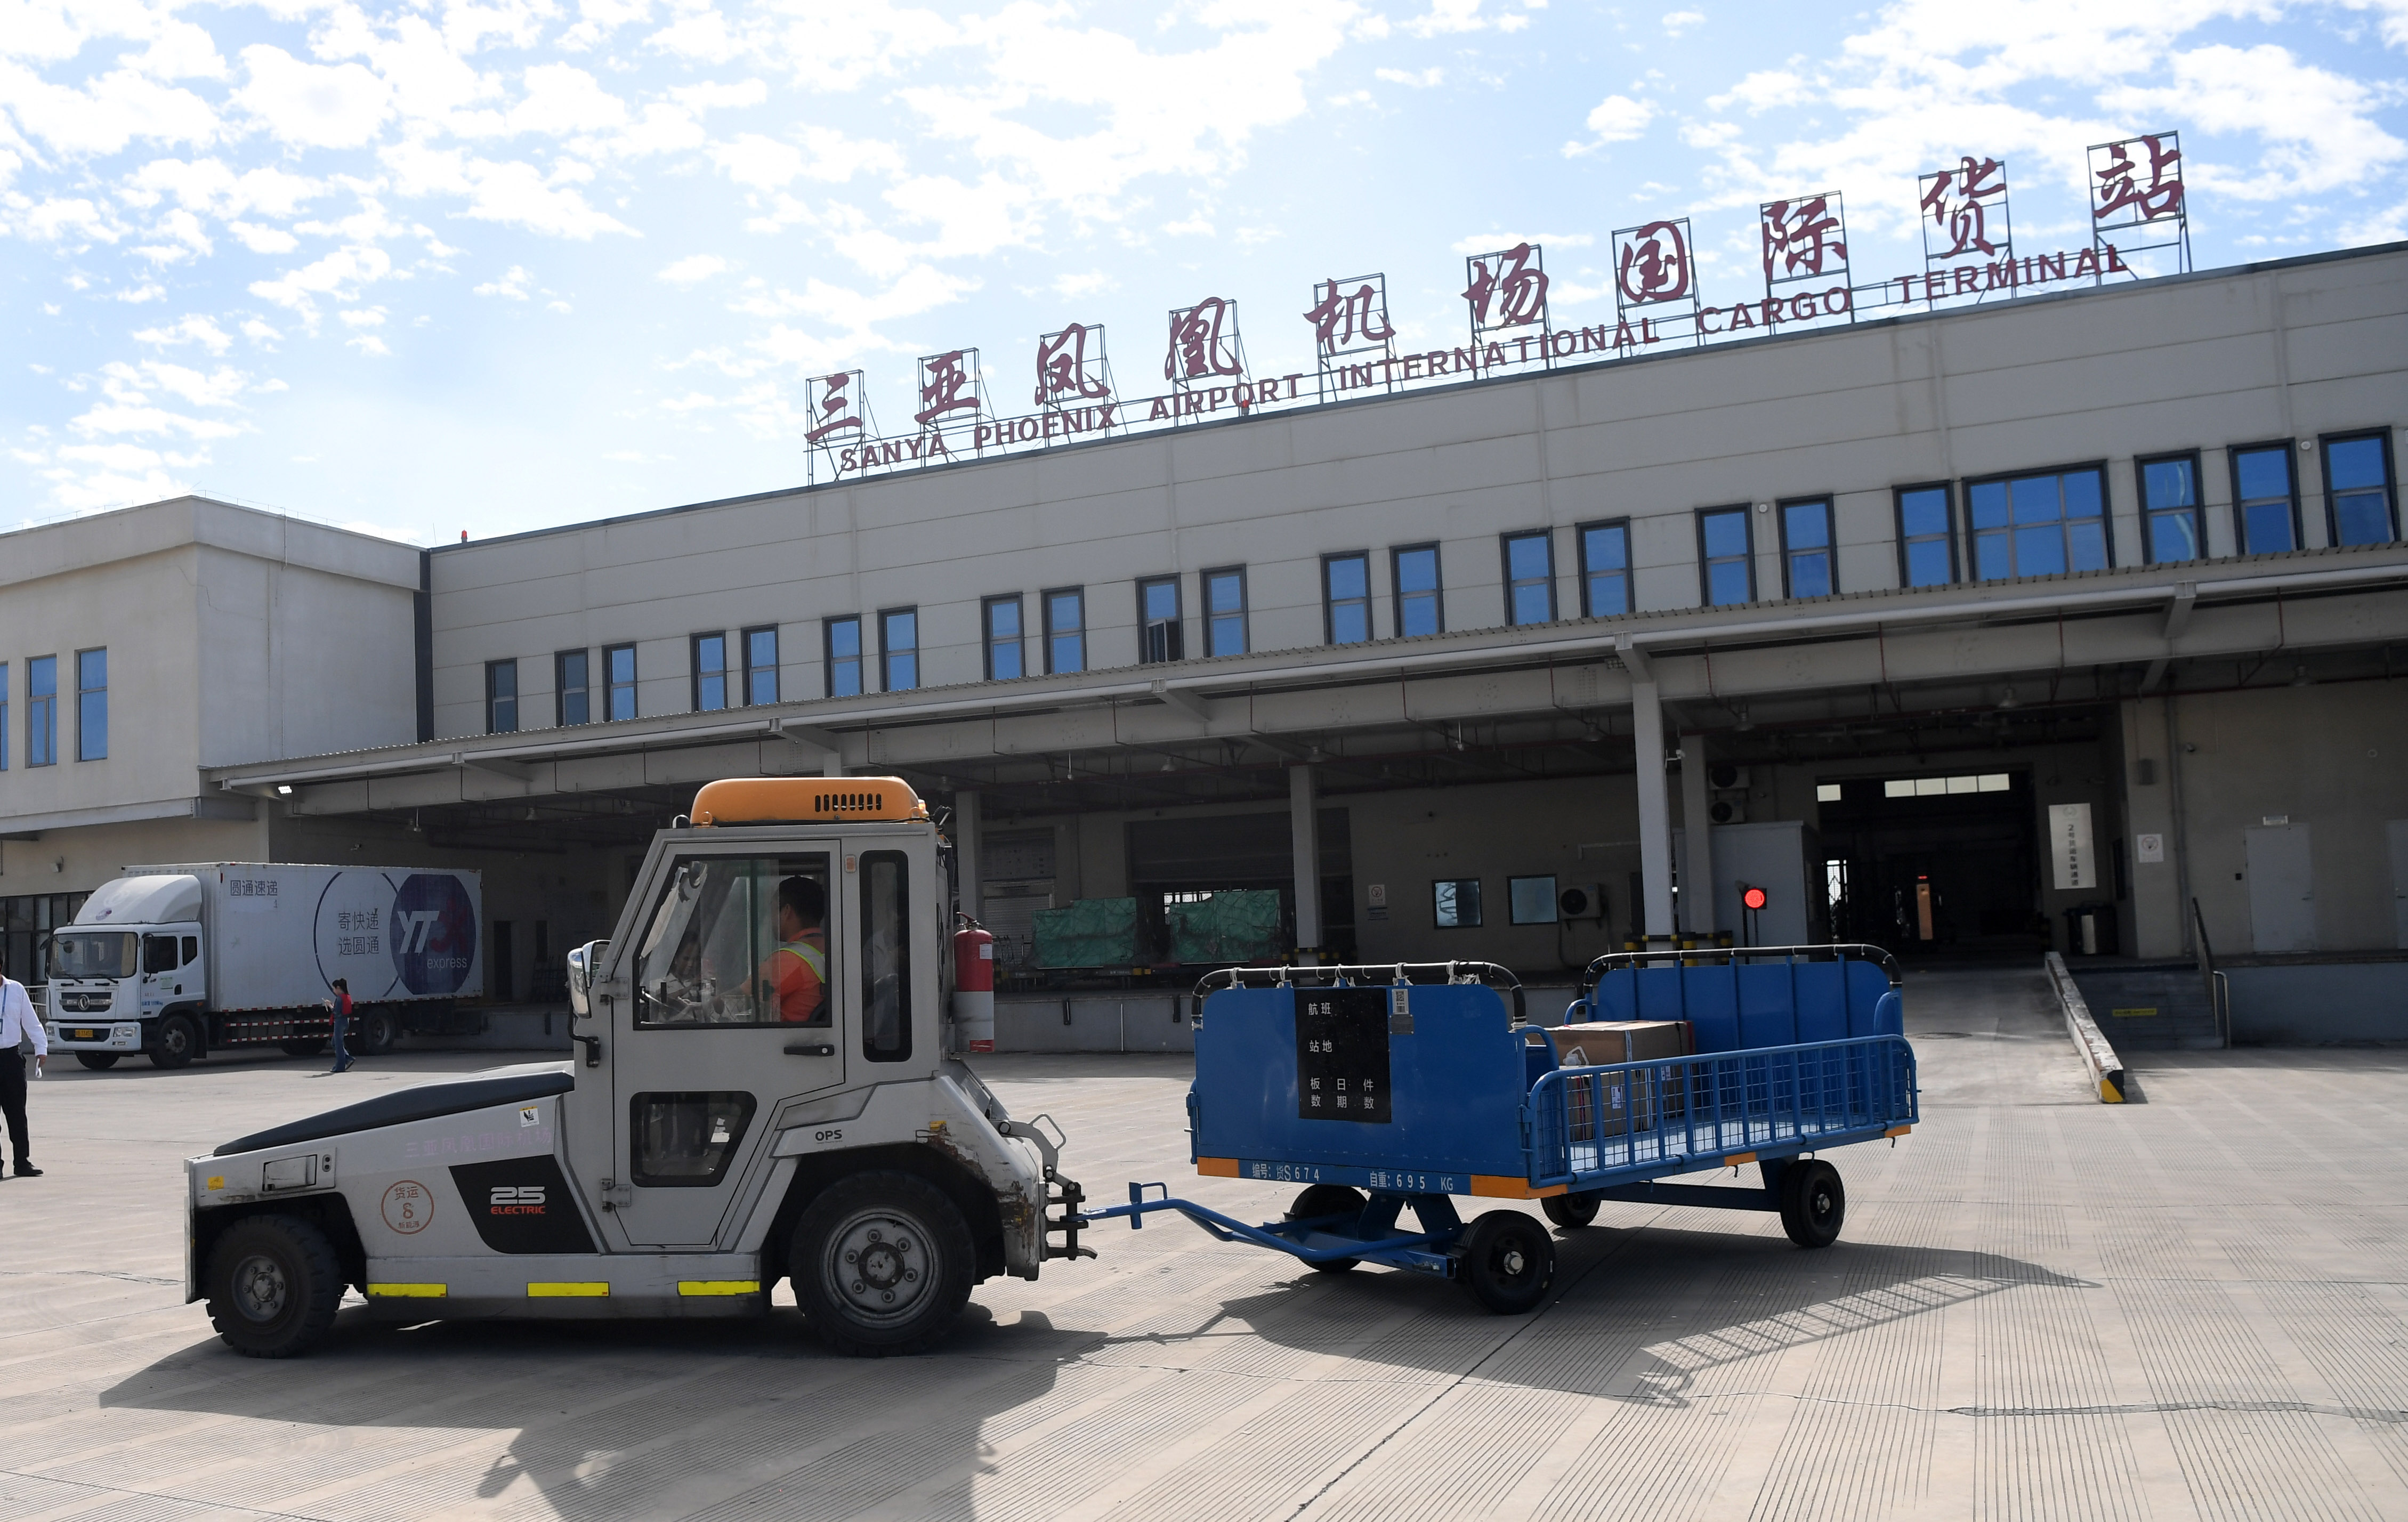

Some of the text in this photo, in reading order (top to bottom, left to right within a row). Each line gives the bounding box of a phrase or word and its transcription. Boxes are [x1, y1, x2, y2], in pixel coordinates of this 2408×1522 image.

[804, 135, 2184, 443] 三亚凤凰机场国际货站
[840, 244, 2128, 472] SANYA PHOENIX AIRPORT INTERNATIONAL CARGO TERMINAL
[230, 880, 277, 896] 圆通速递
[338, 911, 379, 931] 寄快递
[338, 936, 379, 956] 选圆通
[427, 958, 467, 971] express
[1308, 1002, 1331, 1015] 航班
[1309, 1040, 1332, 1053] 站地
[1337, 1079, 1347, 1108] 日期
[1363, 1079, 1375, 1110] 件数
[405, 1127, 552, 1157] 三亚凤凰国际机场
[815, 1129, 842, 1141] OPS
[1441, 1177, 1453, 1191] KG
[394, 1186, 419, 1200] 货运
[491, 1186, 546, 1204] 25
[491, 1205, 546, 1215] ELECTRIC
